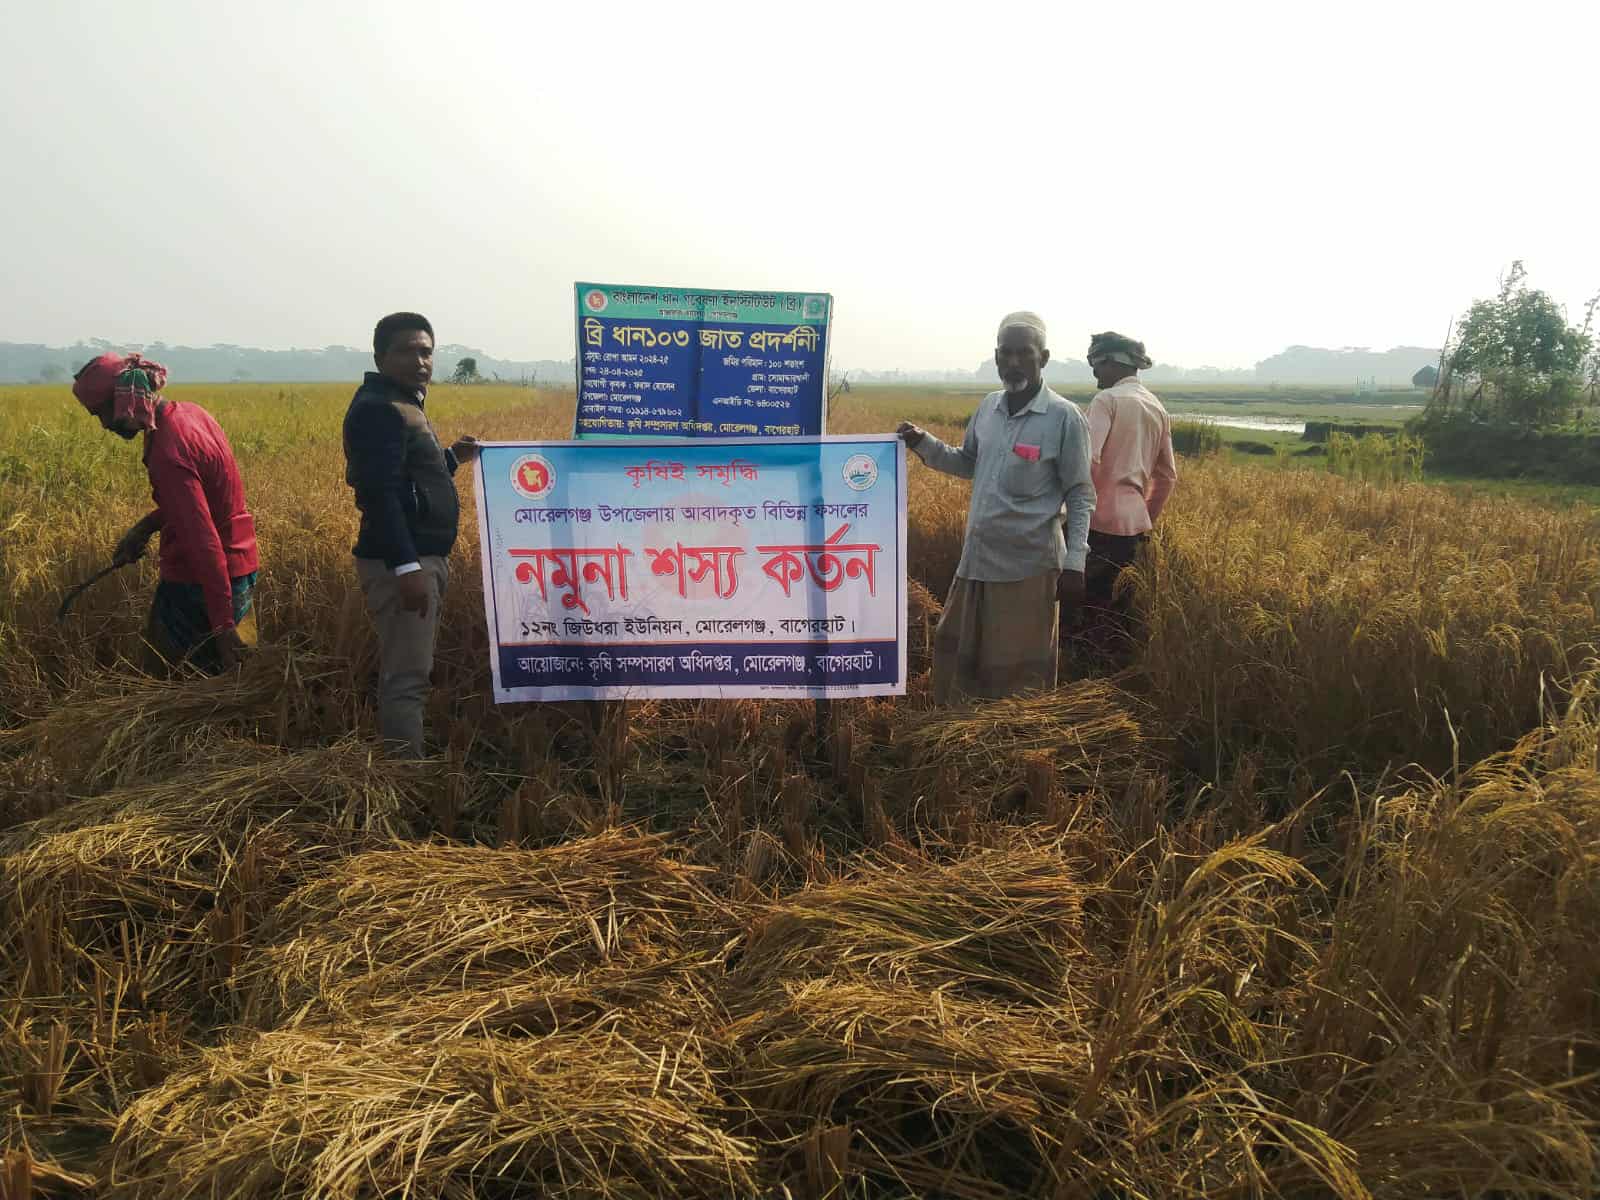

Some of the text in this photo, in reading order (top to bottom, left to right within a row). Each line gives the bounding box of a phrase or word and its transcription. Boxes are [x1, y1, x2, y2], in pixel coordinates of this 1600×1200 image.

[584, 317, 820, 353] ব্রি ধান১০৩ জাত প্রদর্শনী
[624, 457, 760, 488] কৃষিই সমৃদ্ধি
[514, 500, 869, 527] মোরেলগঞ্জ উপজেলায় আবাদকৃত বিভিন্ন ফসলের
[508, 542, 634, 617] নমুনা
[643, 541, 749, 600] শস্য
[756, 522, 882, 598] কর্তন
[520, 620, 560, 637] ১২নং
[562, 616, 619, 637] জিউধরা
[516, 655, 584, 674] আয়োজনে:
[586, 651, 613, 681] কৃষি
